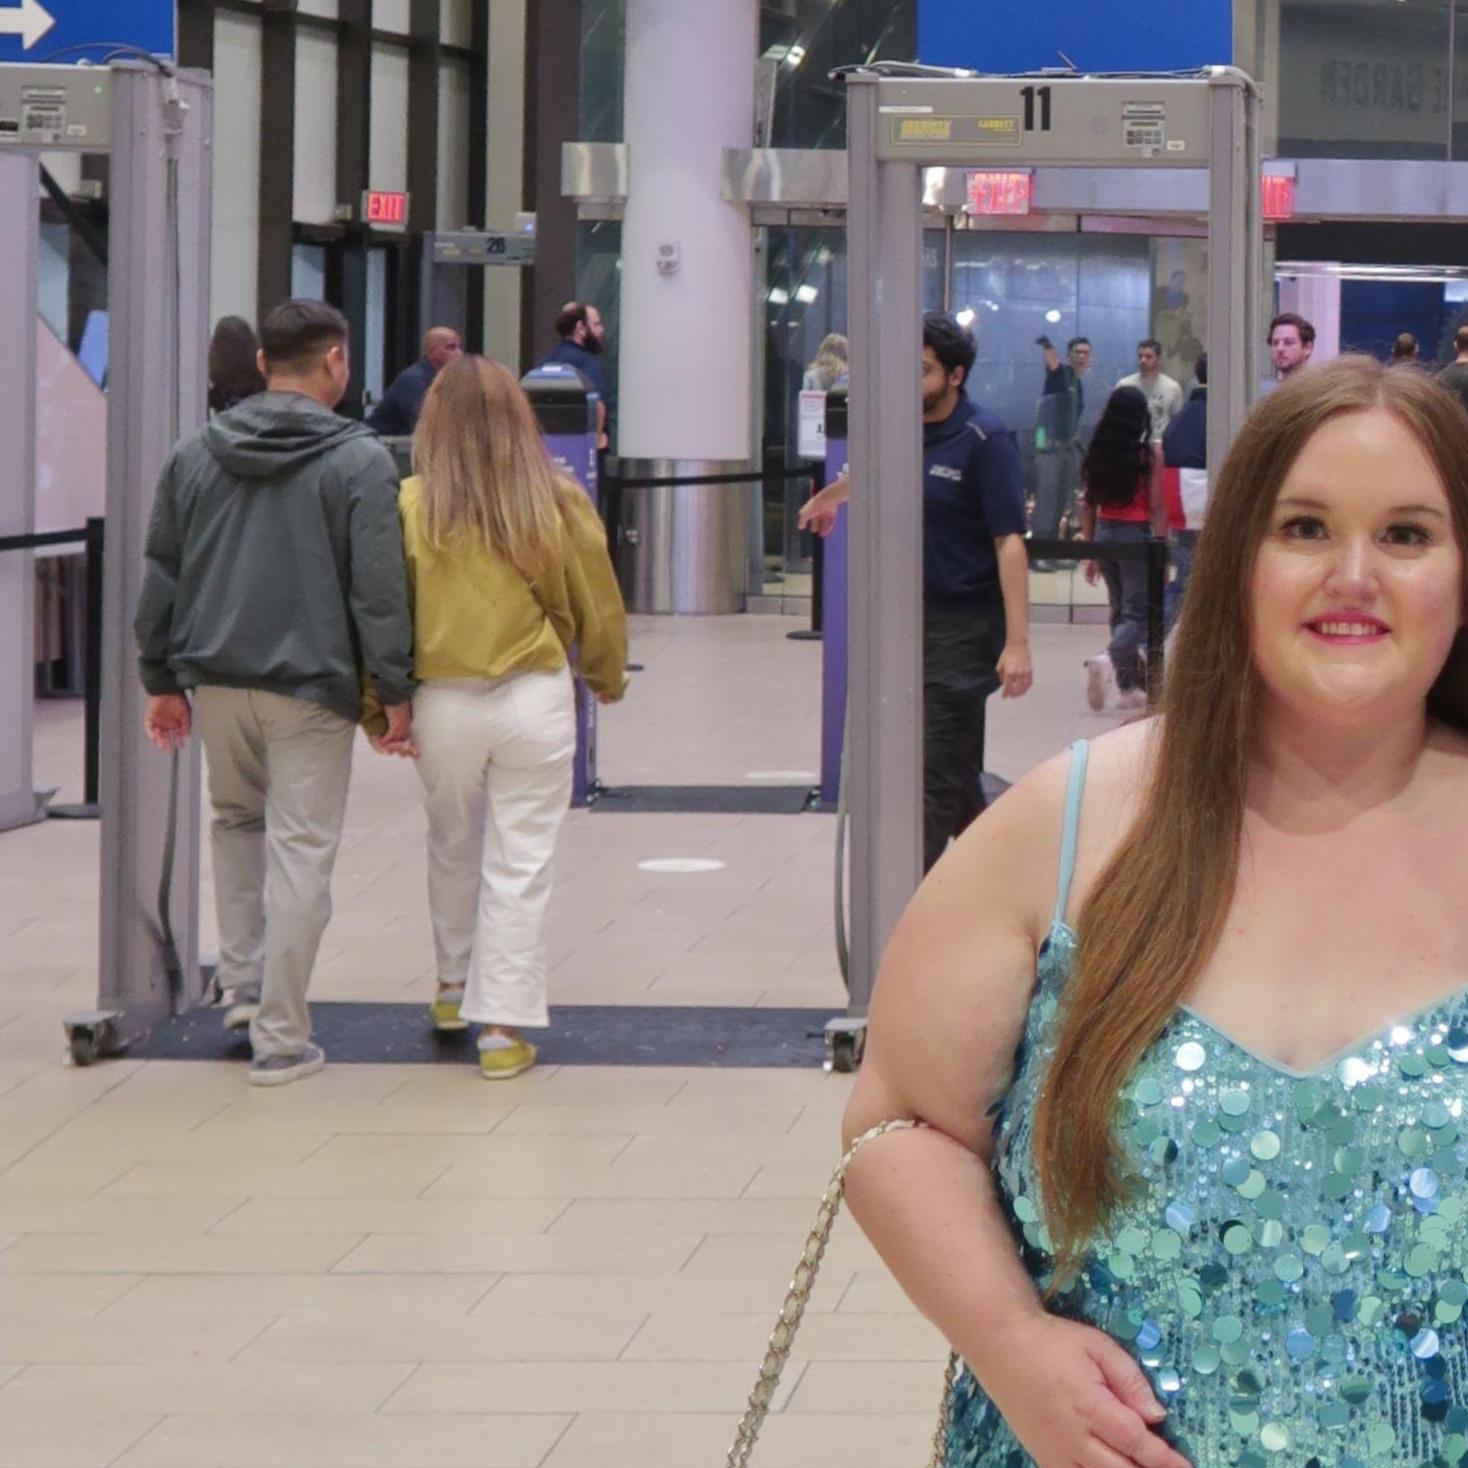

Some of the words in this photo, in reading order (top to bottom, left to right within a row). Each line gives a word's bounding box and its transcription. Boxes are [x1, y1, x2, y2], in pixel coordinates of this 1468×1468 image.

[1020, 86, 1051, 130] 11
[367, 193, 406, 221] EXIT
[975, 173, 1020, 214] EXIT
